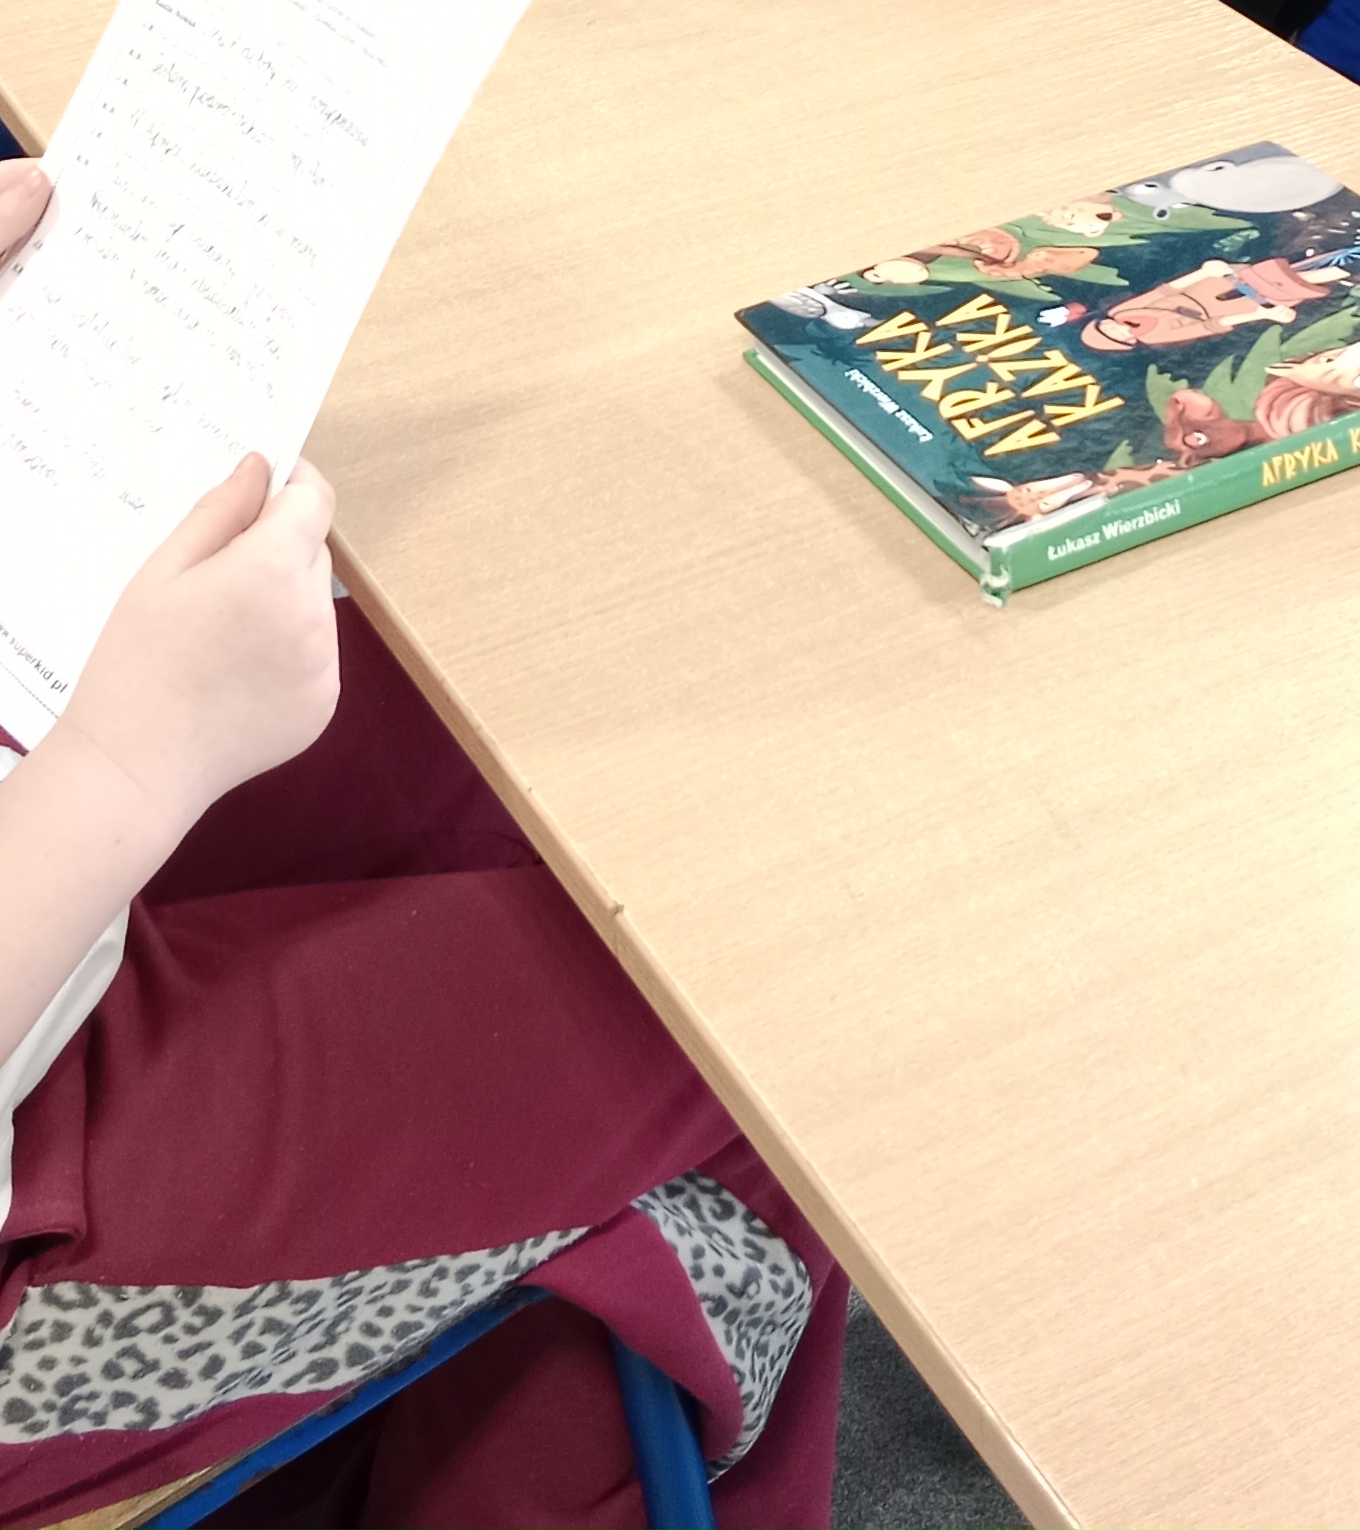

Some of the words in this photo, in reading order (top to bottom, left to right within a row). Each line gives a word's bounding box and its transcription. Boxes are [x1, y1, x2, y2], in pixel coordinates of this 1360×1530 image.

[855, 311, 1061, 457] AFRYKA
[935, 293, 1127, 427] KAZIKA
[1262, 437, 1339, 486] AFRYKA
[1047, 532, 1100, 561] Łukasz
[1101, 499, 1181, 541] Wierzbicki
